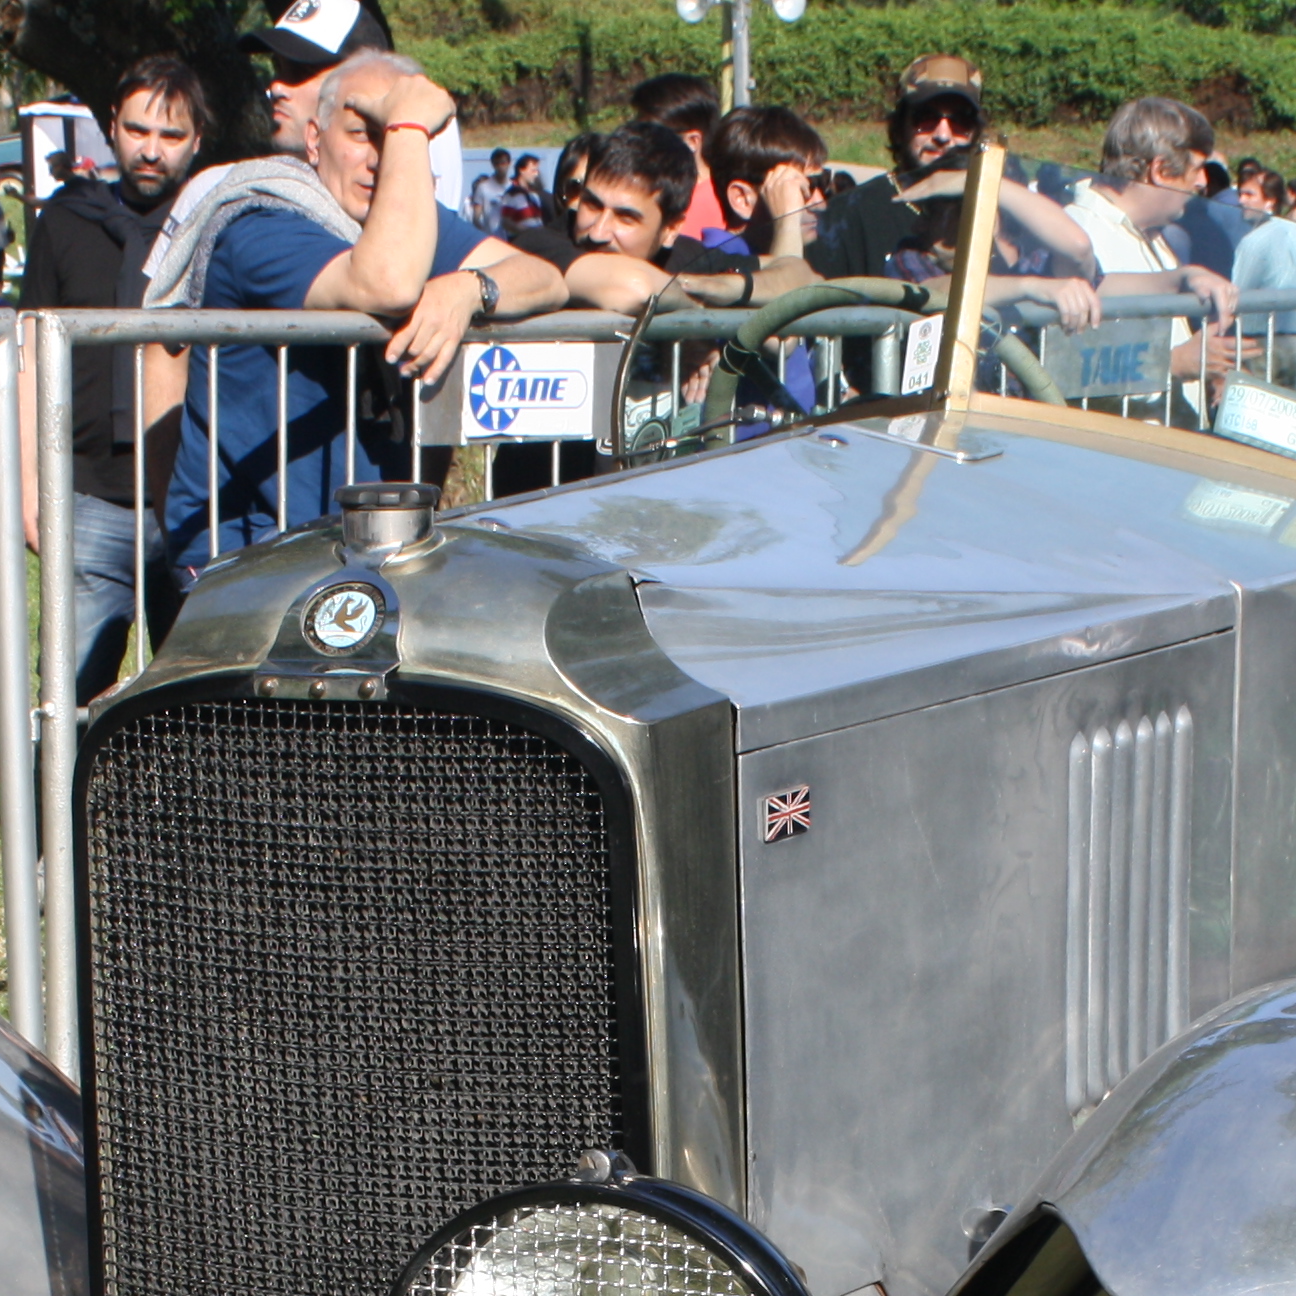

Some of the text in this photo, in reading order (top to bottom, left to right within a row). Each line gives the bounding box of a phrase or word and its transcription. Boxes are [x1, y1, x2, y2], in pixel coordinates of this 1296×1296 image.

[1079, 342, 1150, 387] TANE
[497, 377, 569, 402] TANE
[908, 372, 929, 390] 041
[1287, 432, 1296, 446] G
